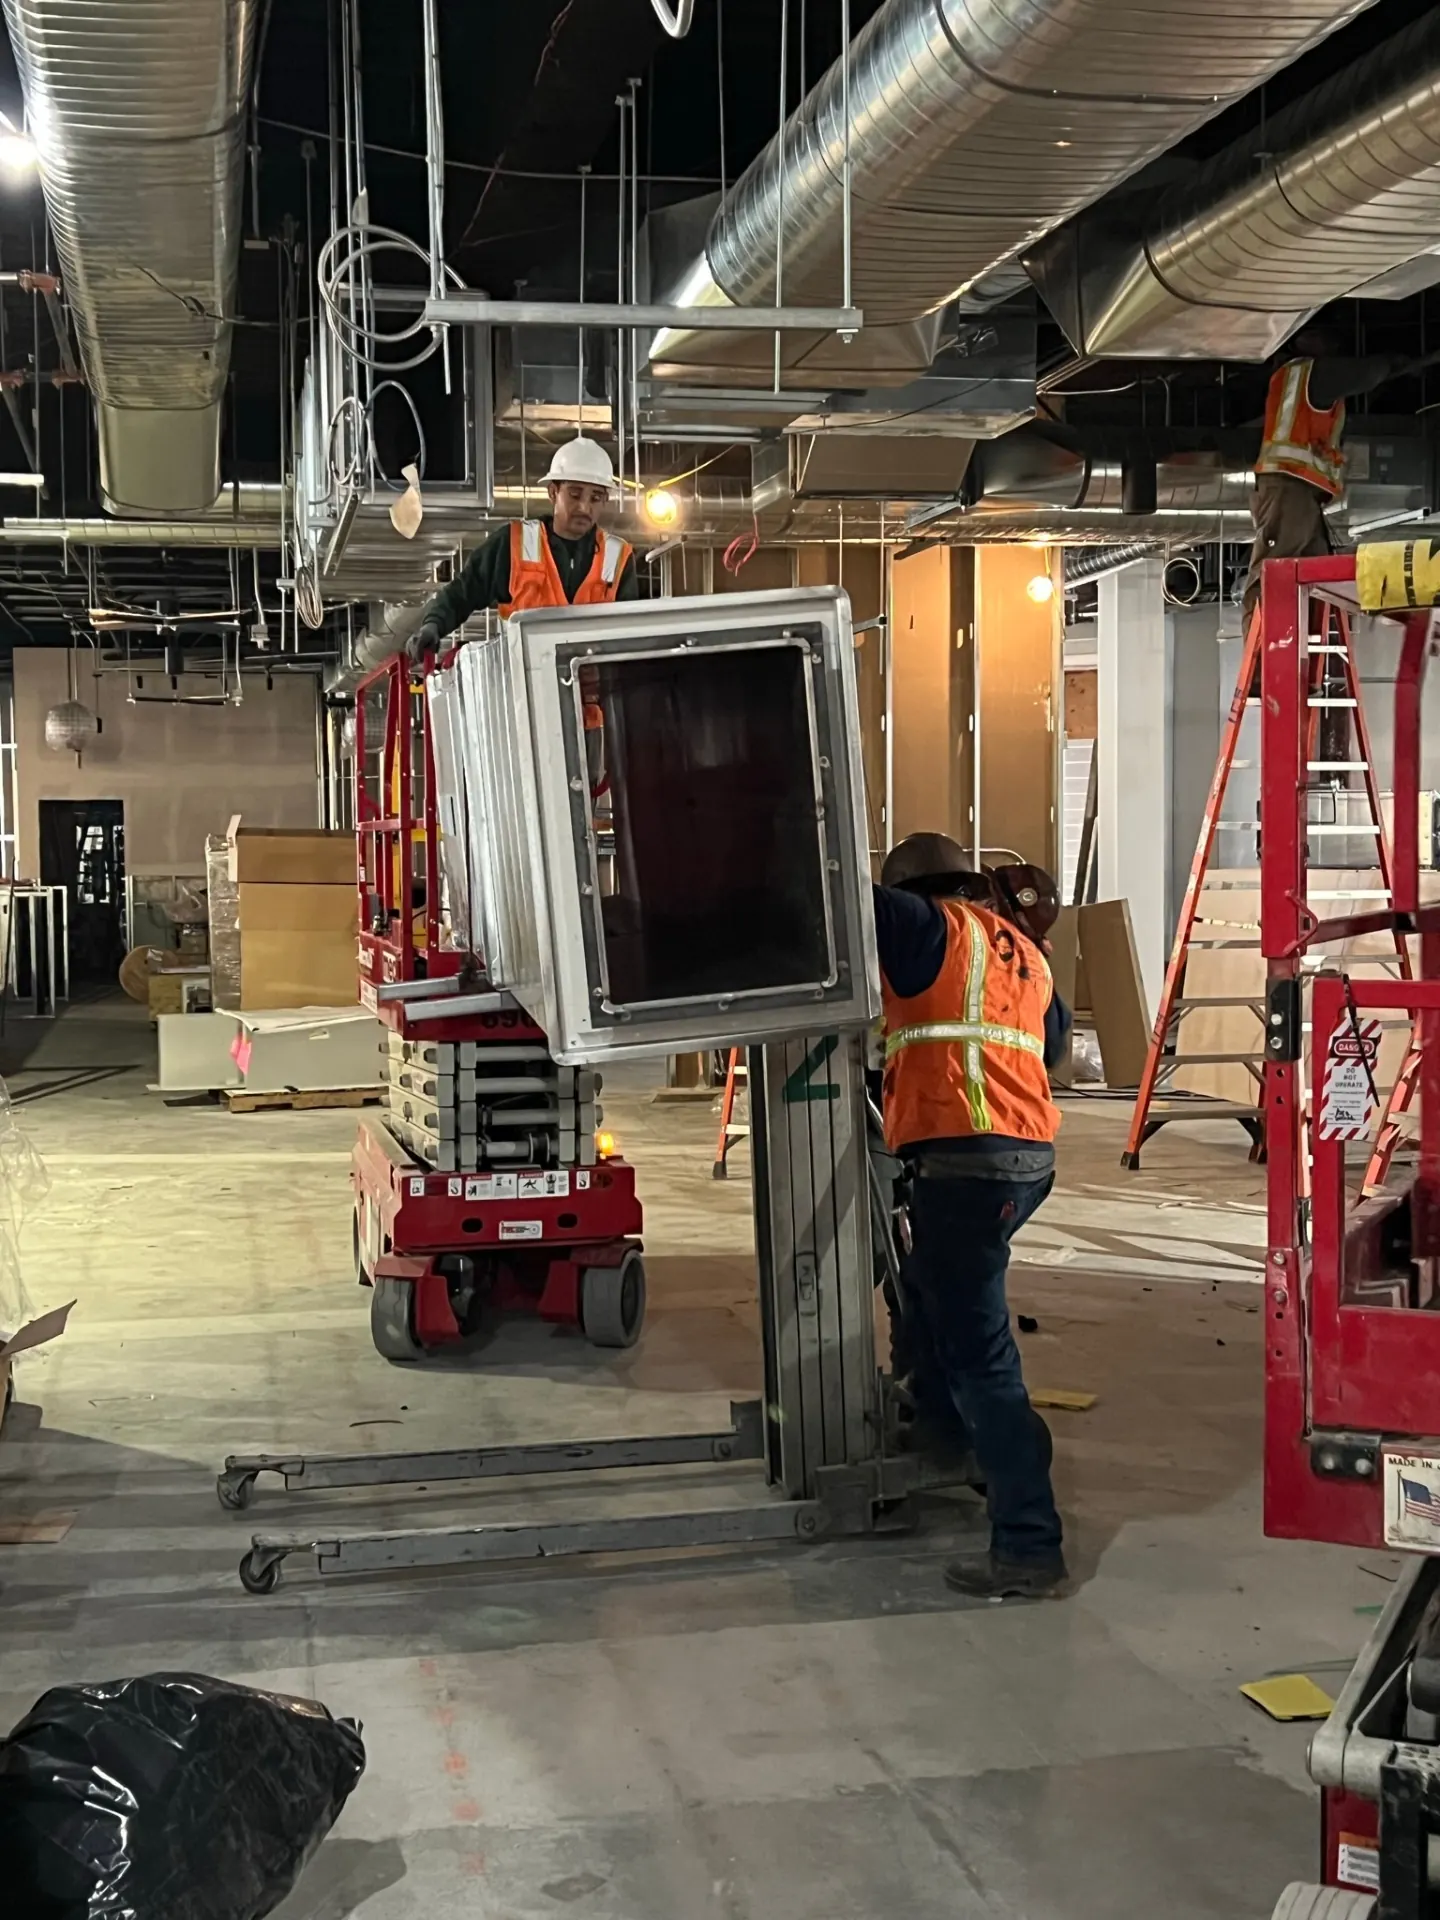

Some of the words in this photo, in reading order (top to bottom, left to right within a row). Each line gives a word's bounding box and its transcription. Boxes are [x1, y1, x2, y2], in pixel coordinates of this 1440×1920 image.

[1338, 1043, 1370, 1051] DANGR
[1388, 1457, 1416, 1467] MADE
[1421, 1460, 1432, 1469] IN
